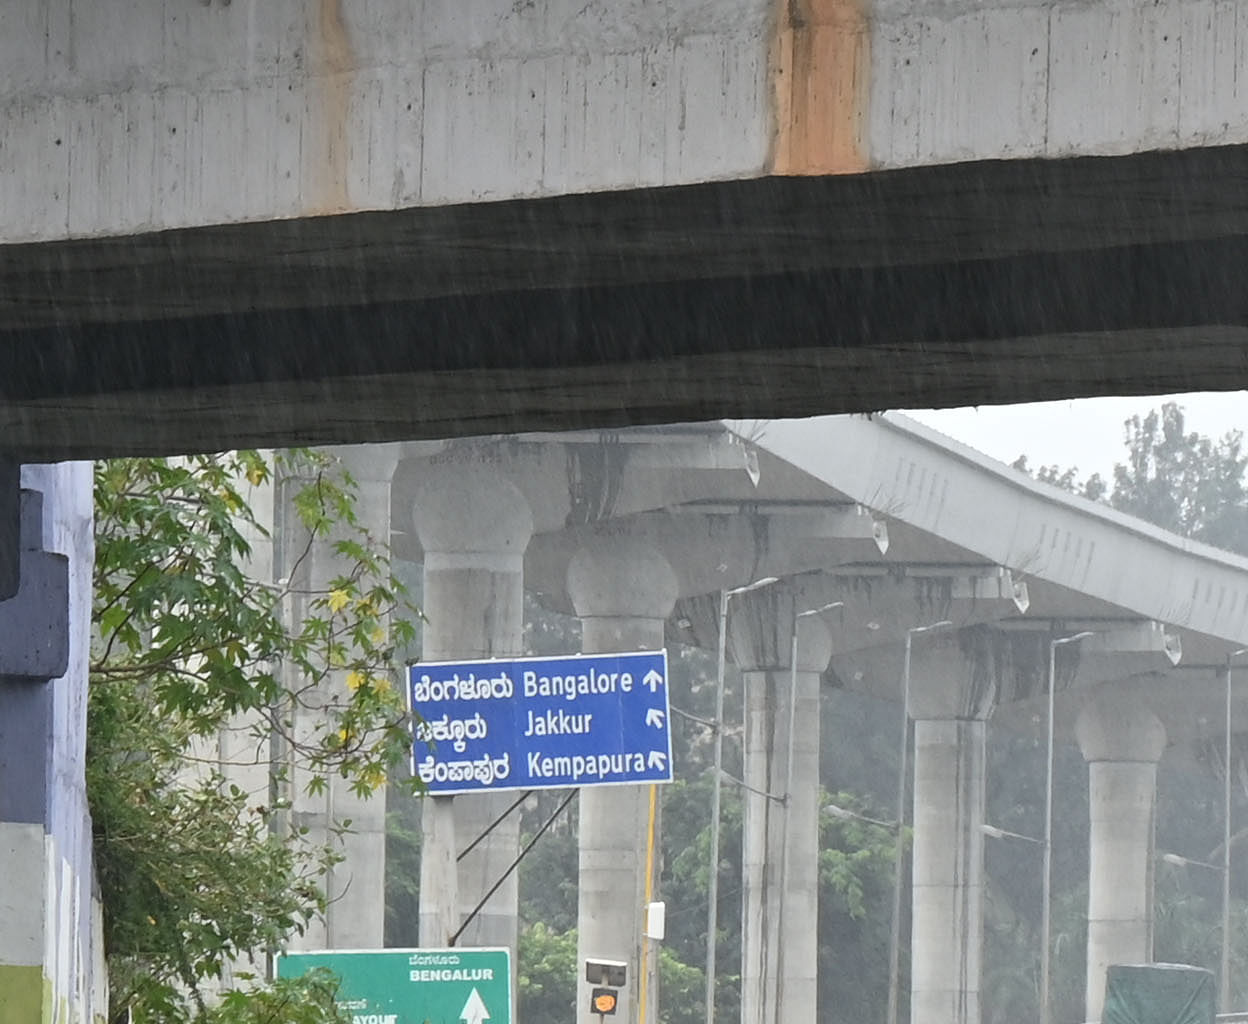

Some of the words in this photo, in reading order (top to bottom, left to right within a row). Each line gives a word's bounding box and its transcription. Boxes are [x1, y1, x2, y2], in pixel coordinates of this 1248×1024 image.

[414, 671, 513, 702] ಬೆಂಗಳೂರು
[523, 668, 633, 700] Bangalore
[524, 709, 593, 737] Jakkur
[418, 751, 510, 785] ಕೆಂಪಾಪುರ
[527, 750, 646, 781] Kempapura
[409, 968, 494, 982] BENGALUR
